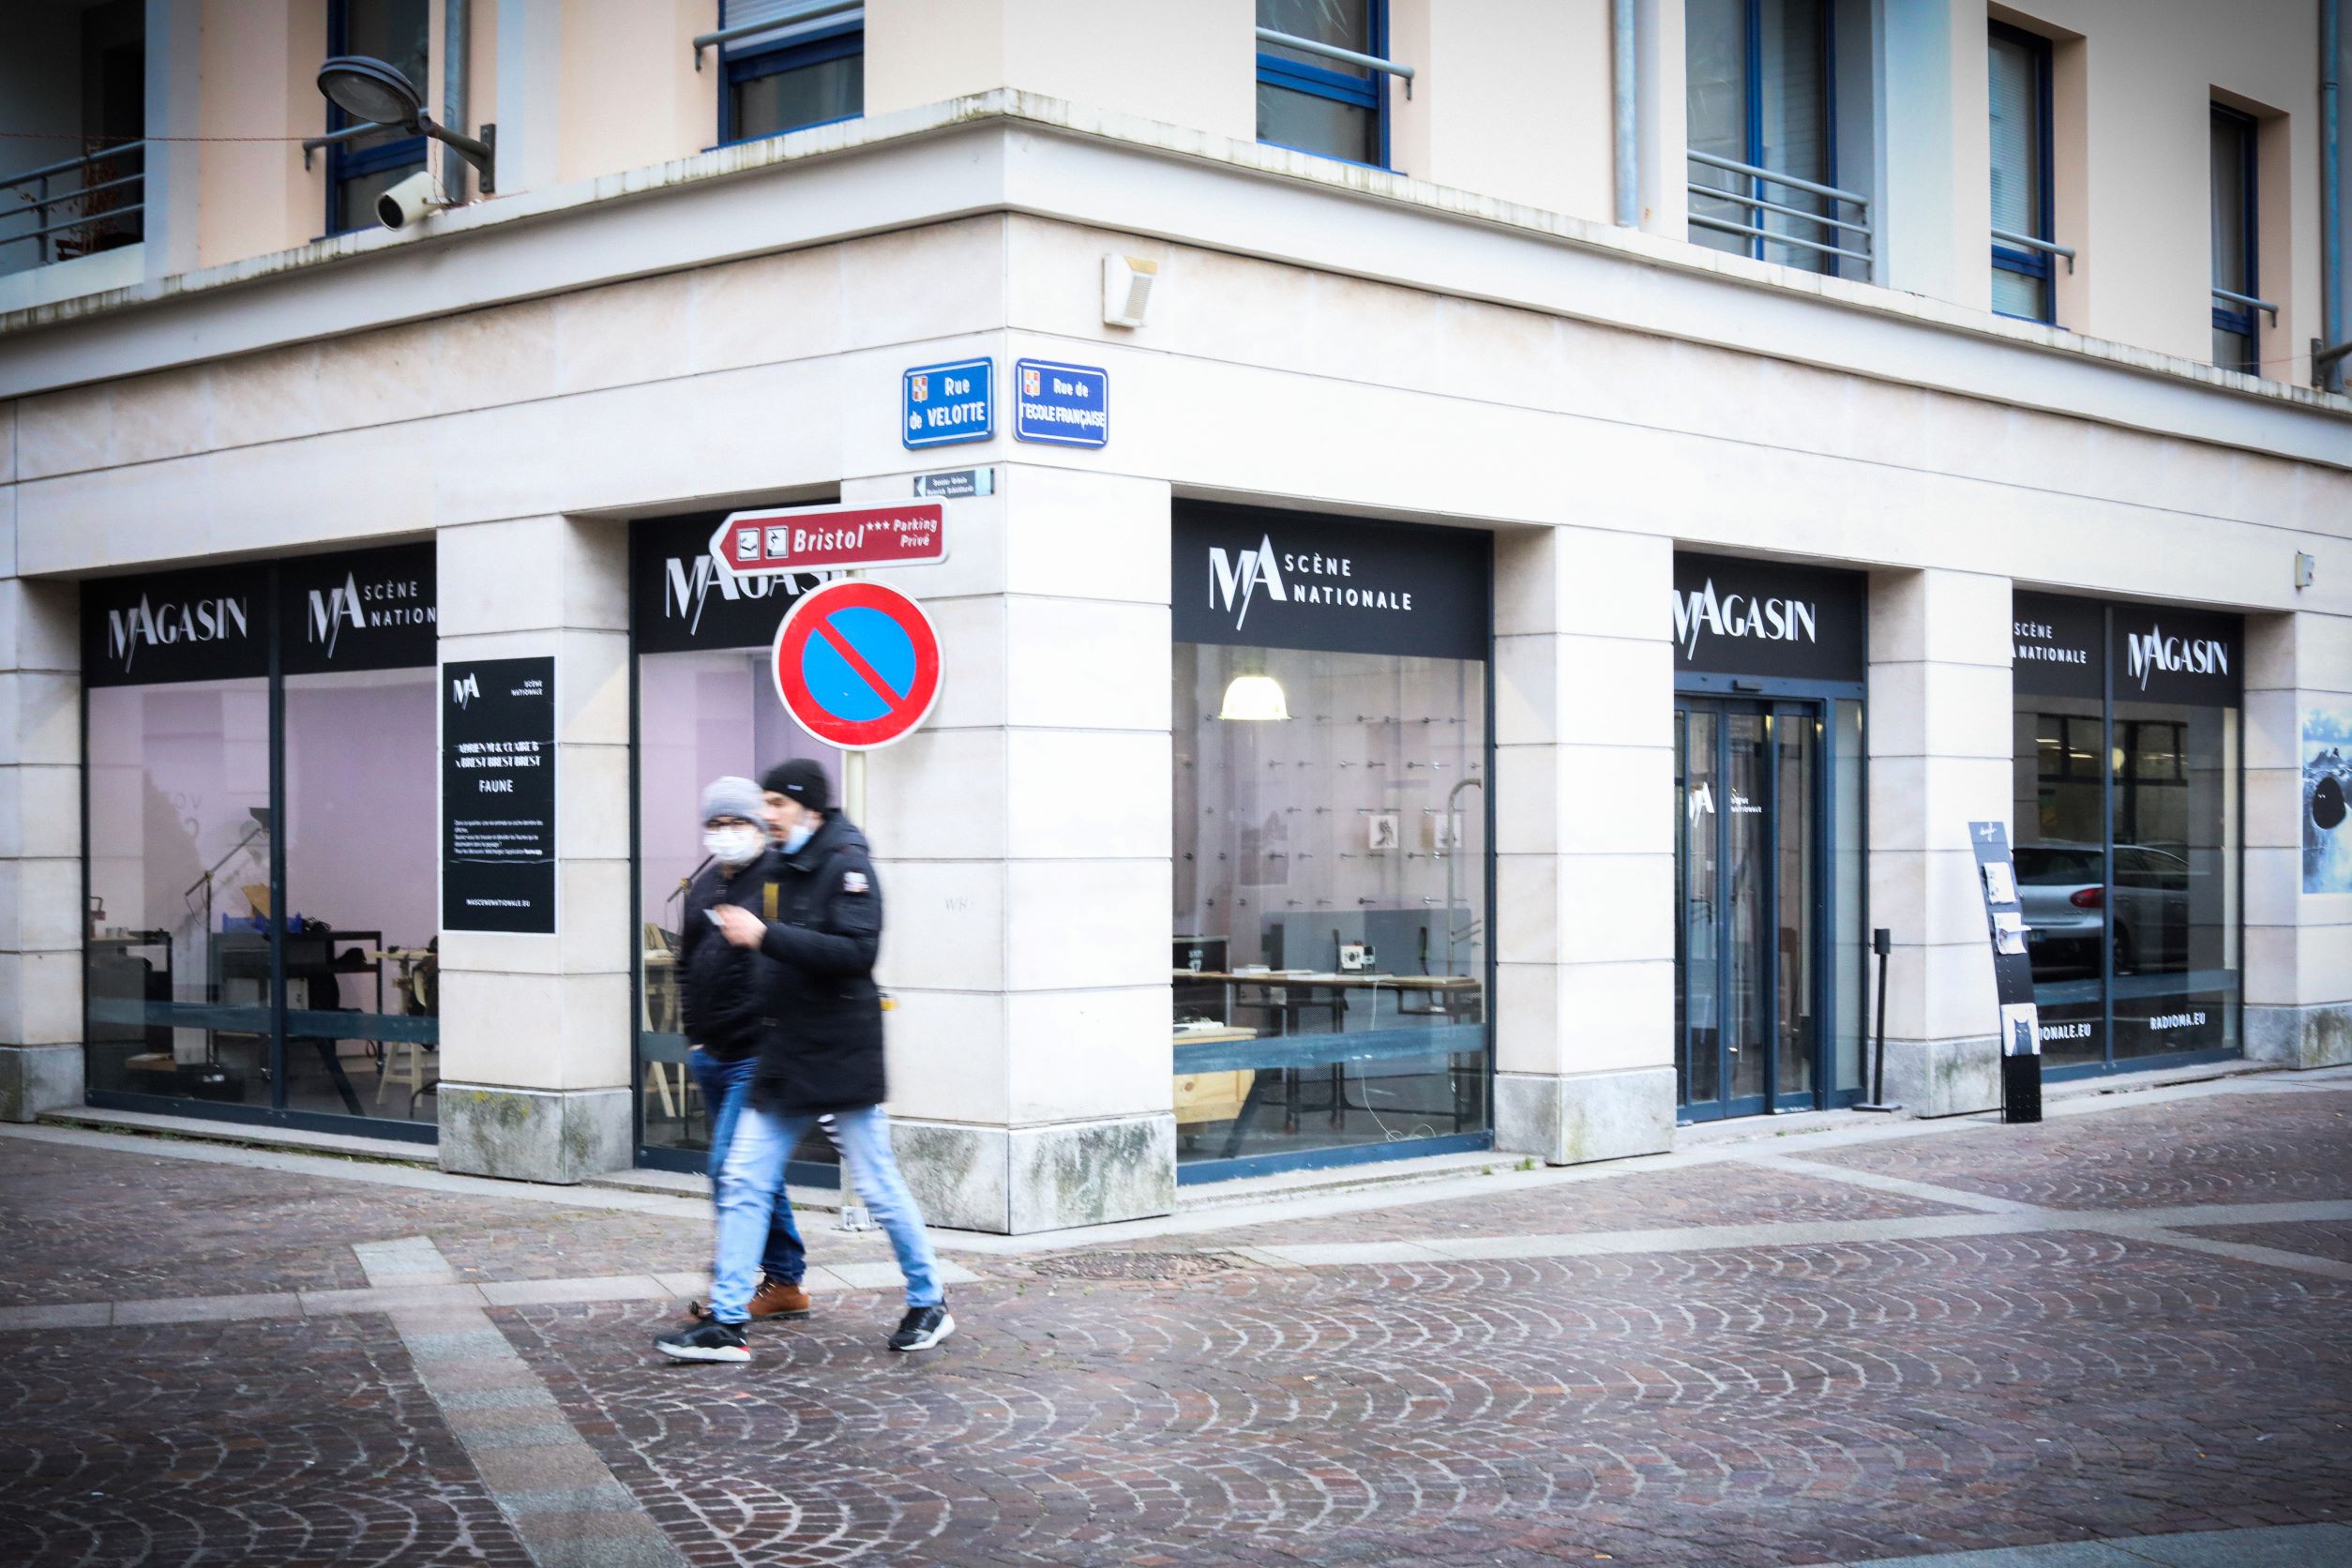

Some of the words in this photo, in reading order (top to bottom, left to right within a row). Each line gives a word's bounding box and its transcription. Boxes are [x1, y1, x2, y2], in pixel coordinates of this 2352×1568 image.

[944, 377, 970, 396] Rue
[1053, 378, 1073, 395] Rue
[1076, 381, 1089, 398] de
[910, 411, 923, 430] de
[927, 401, 985, 427] VELOTTE
[1056, 406, 1106, 430] FRANÇAISE
[793, 524, 865, 553] Bristol
[893, 519, 937, 532] Parking
[900, 534, 930, 548] Privé
[1209, 532, 1287, 631] MA
[1284, 552, 1351, 577] SCÈNE
[1293, 584, 1412, 611] NATIONALE
[309, 570, 366, 658] MA
[364, 580, 418, 601] SCÈNE
[1673, 577, 1816, 660] MAGASIN
[109, 591, 247, 674] MAGASIN
[2014, 620, 2053, 639] SCÈNE
[2018, 644, 2087, 664] NATIONALE
[2128, 624, 2228, 691] MAGASIN
[453, 671, 480, 710] MA
[479, 779, 513, 792] FAUNE
[2149, 1012, 2206, 1030] RADIOMA.EU
